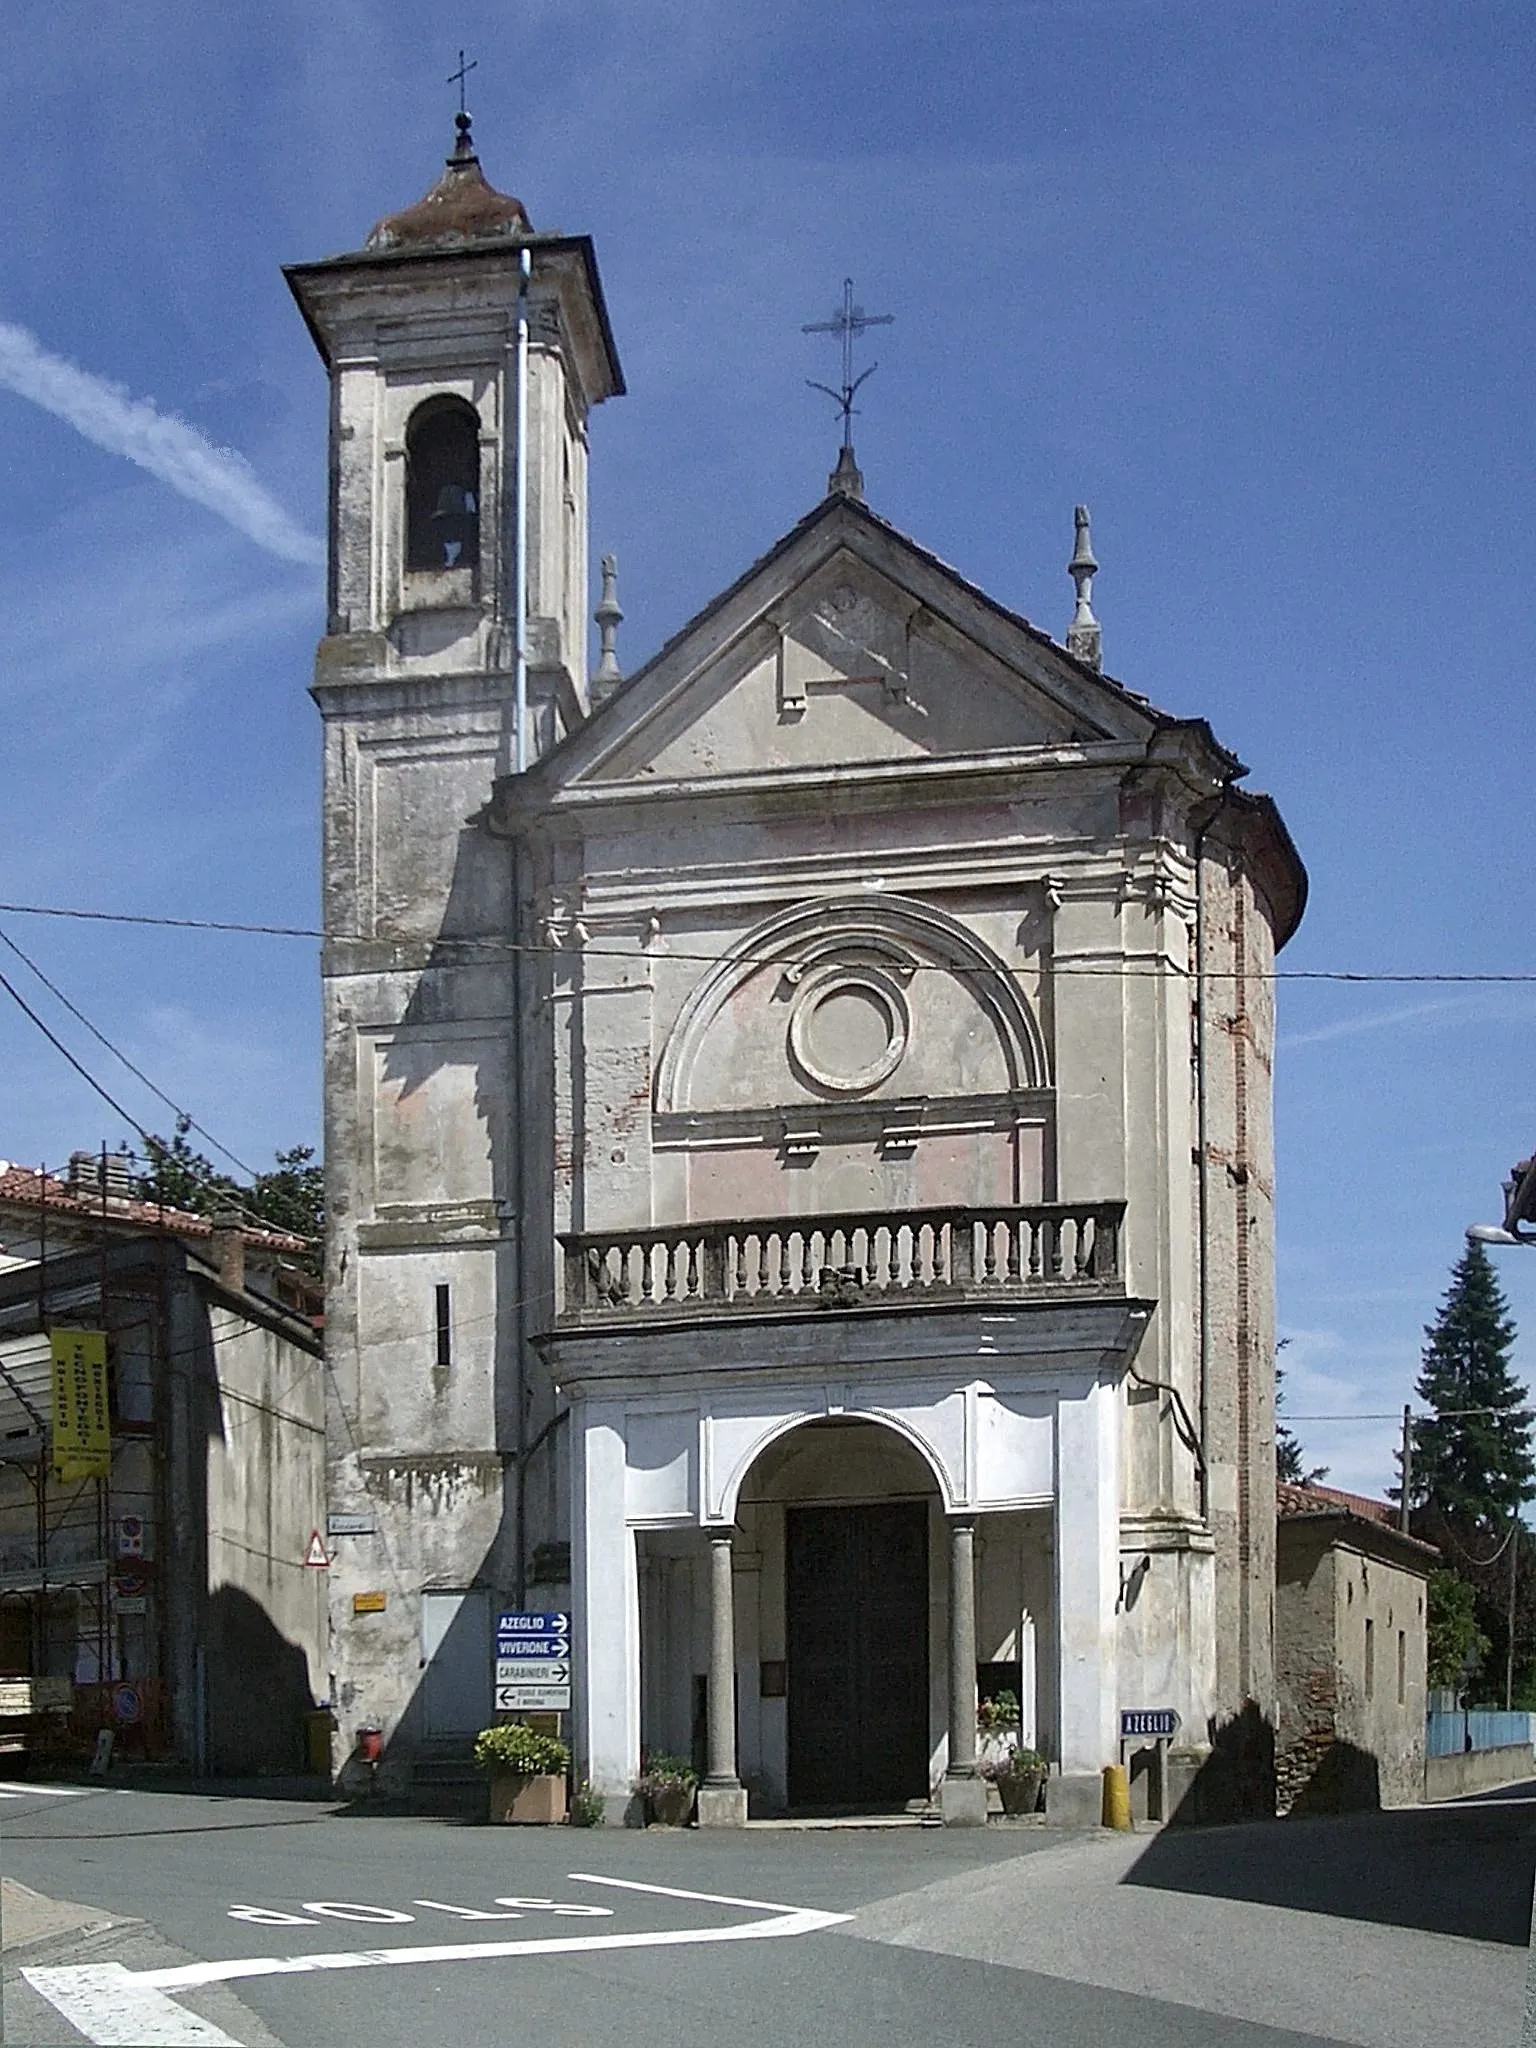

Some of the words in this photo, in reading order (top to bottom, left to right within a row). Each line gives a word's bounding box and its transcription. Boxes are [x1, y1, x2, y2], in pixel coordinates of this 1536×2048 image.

[500, 1617, 544, 1630] AZEGLIO
[500, 1641, 549, 1654] VIVERONE
[500, 1667, 549, 1679] CARABINIERI
[227, 1898, 614, 1926] STOP
